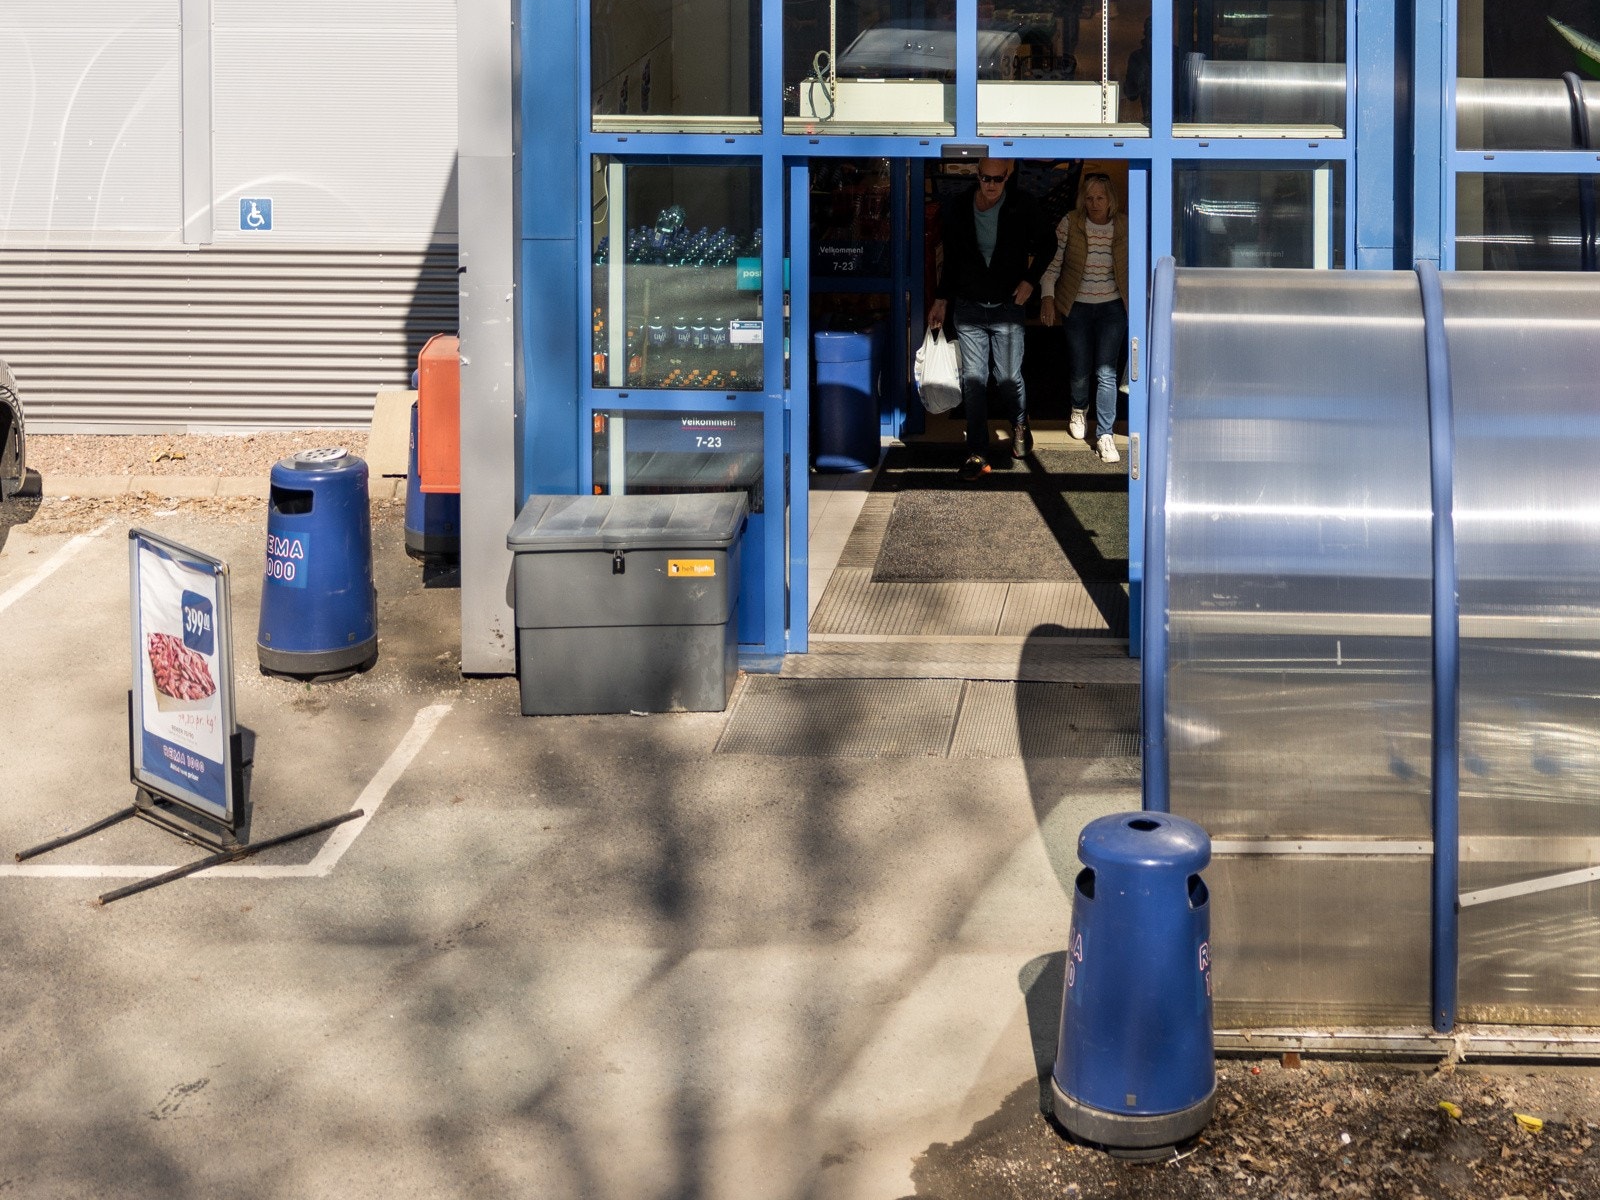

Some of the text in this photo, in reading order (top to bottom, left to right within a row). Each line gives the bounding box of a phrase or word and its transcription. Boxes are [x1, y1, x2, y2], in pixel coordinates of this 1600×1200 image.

[820, 246, 864, 254] Velkommen!
[833, 261, 854, 271] 7-23
[681, 417, 737, 426] Velkommen!
[695, 436, 722, 448] 7-23
[266, 534, 304, 559] EMA
[266, 557, 295, 581] 000
[163, 744, 186, 766] REMA
